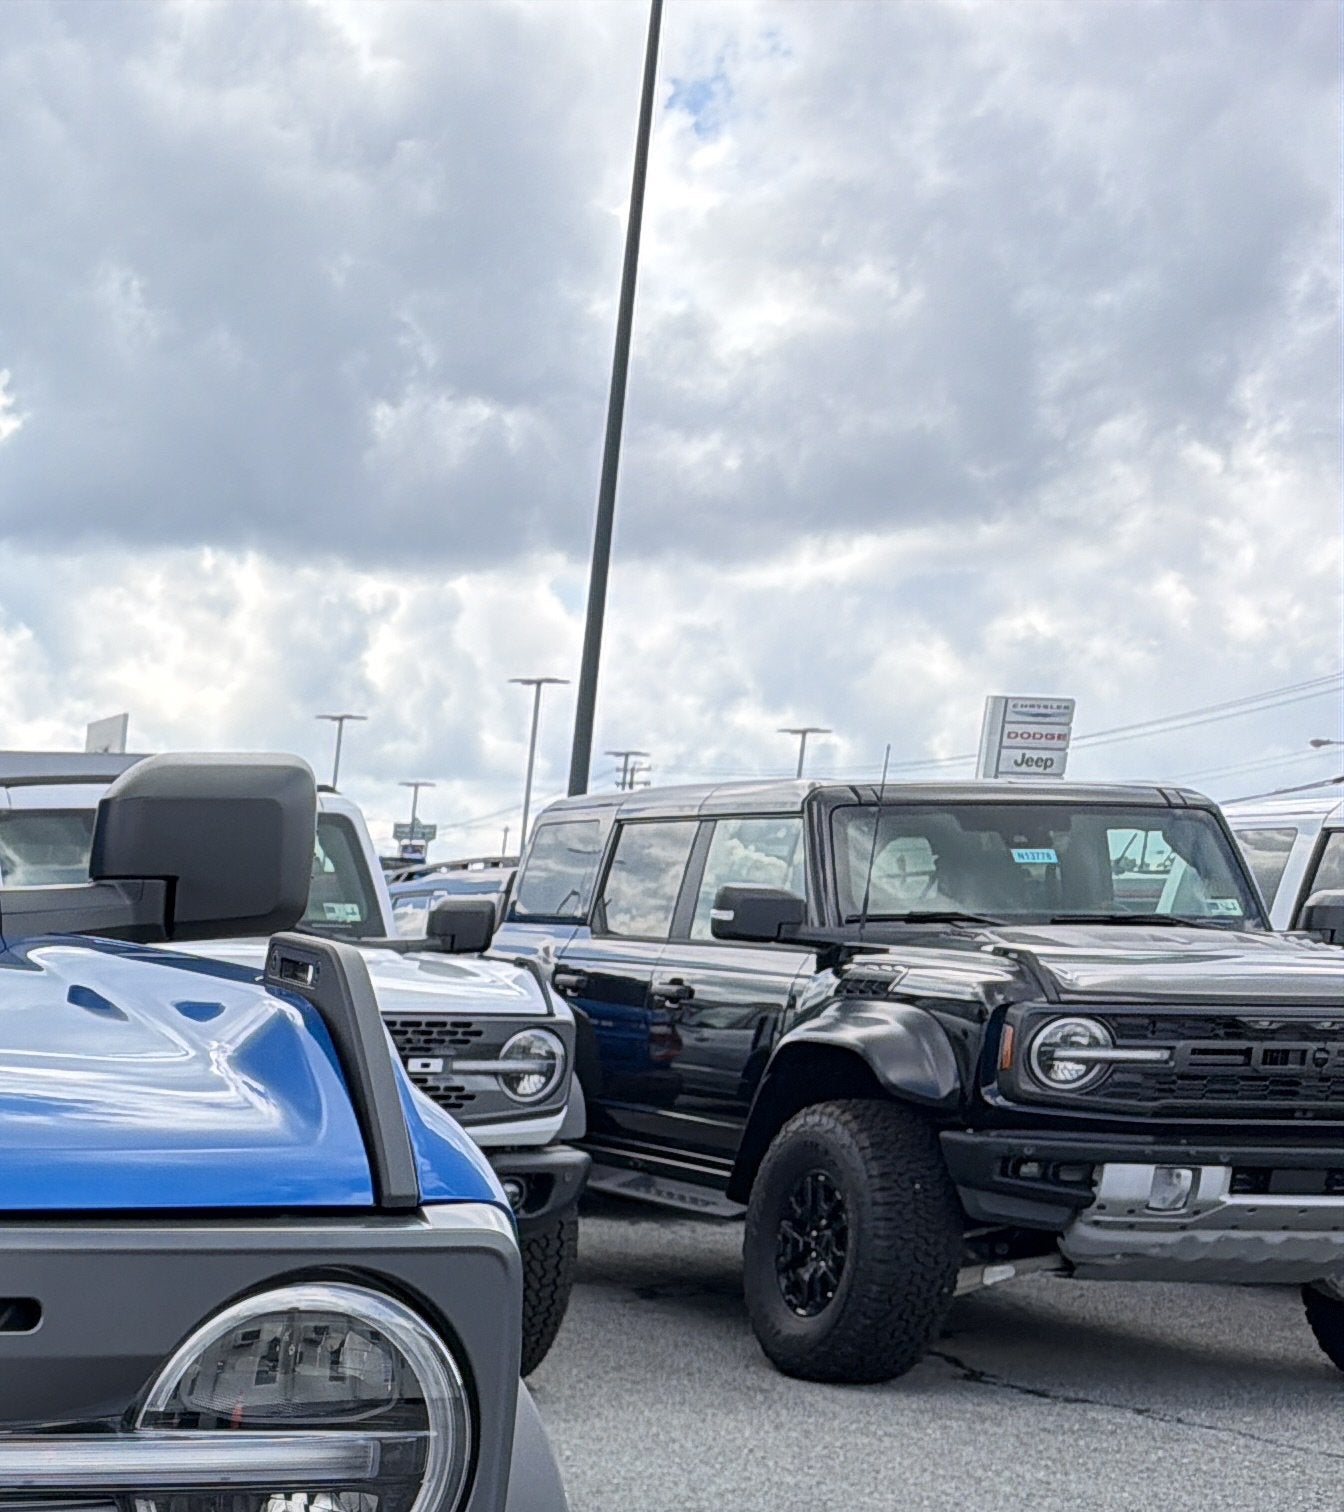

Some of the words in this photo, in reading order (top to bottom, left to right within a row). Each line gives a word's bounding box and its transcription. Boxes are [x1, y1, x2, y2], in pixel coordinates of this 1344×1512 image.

[1011, 702, 1070, 711] CHRYSLER
[1006, 730, 1068, 742] DODGE
[1013, 752, 1055, 771] Jeep
